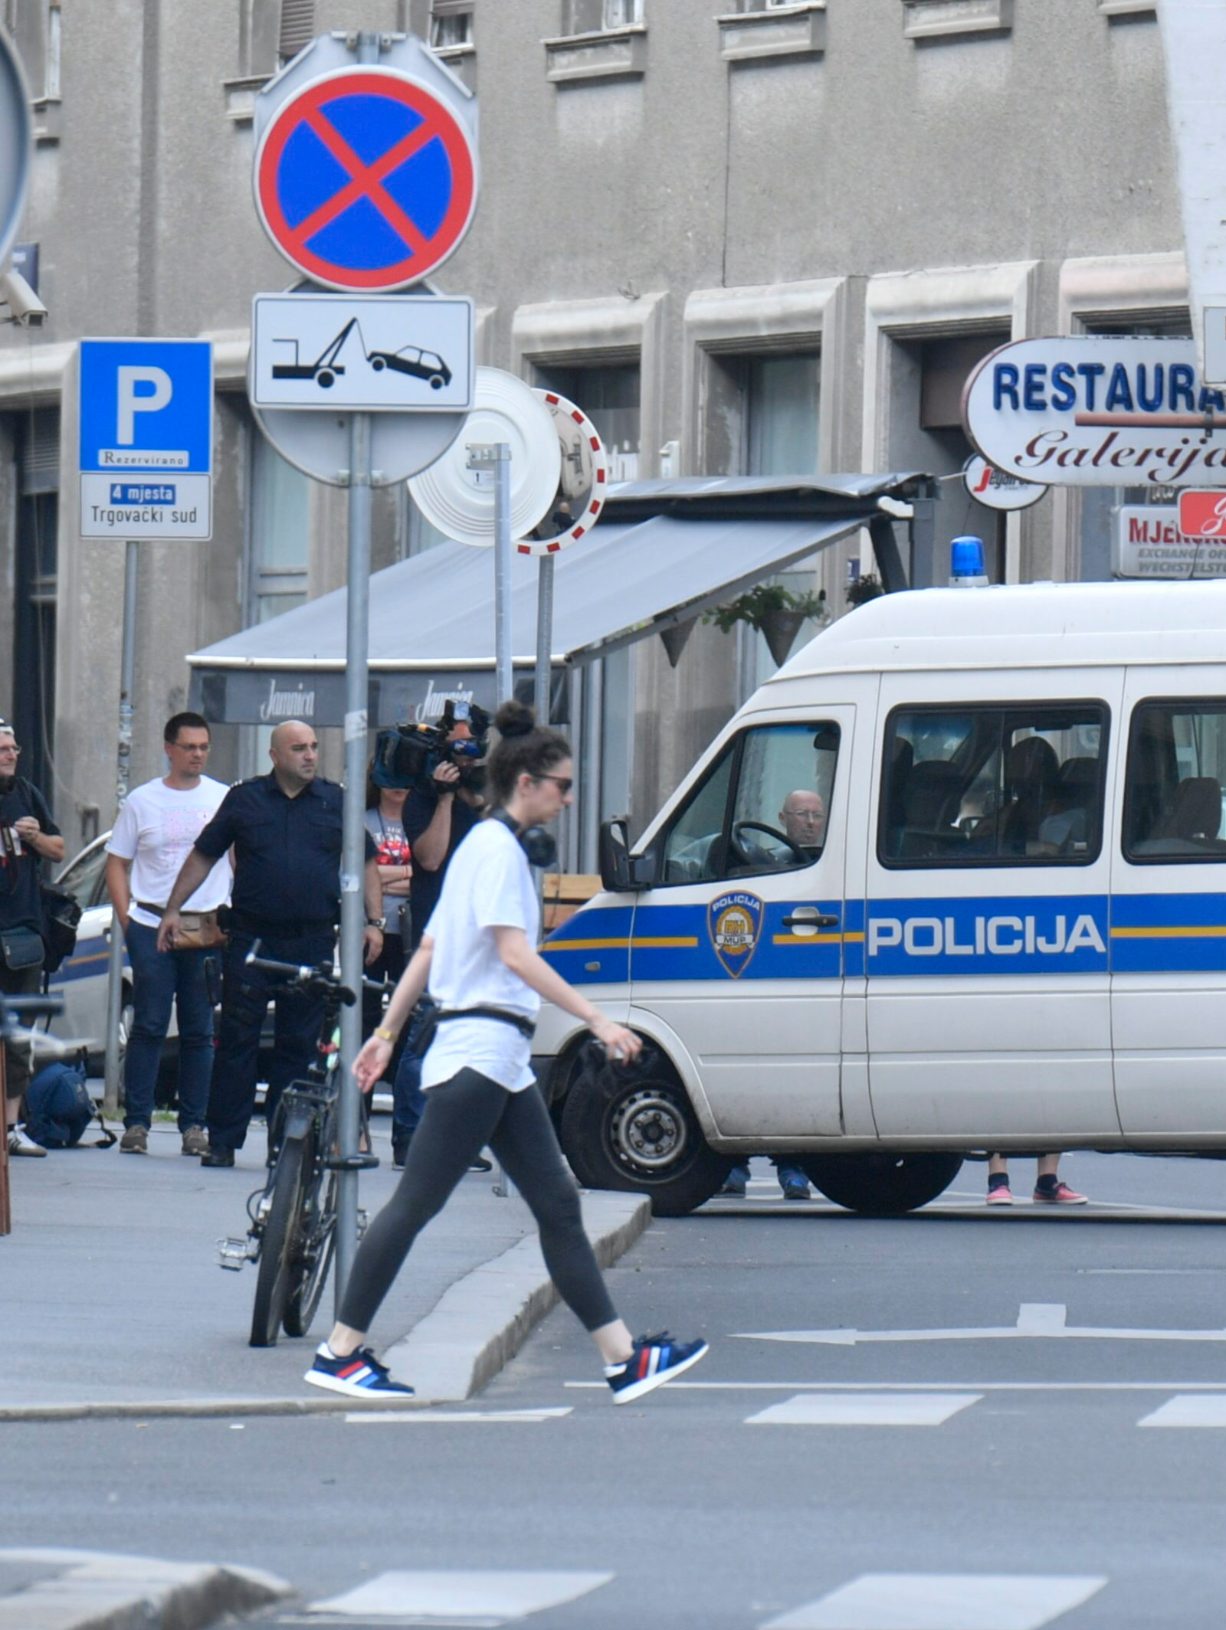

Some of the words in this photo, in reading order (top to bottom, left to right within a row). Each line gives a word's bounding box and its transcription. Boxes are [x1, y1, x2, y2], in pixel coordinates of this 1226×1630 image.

[117, 365, 173, 445] P
[104, 451, 184, 465] Rezervirano
[112, 485, 122, 499] 4
[127, 485, 173, 503] mjesta
[91, 504, 164, 527] Trgovački
[171, 506, 198, 523] sud
[1138, 548, 1206, 559] EXCHANGE
[711, 894, 761, 913] POLICIJA
[868, 915, 1106, 956] POLICIJA
